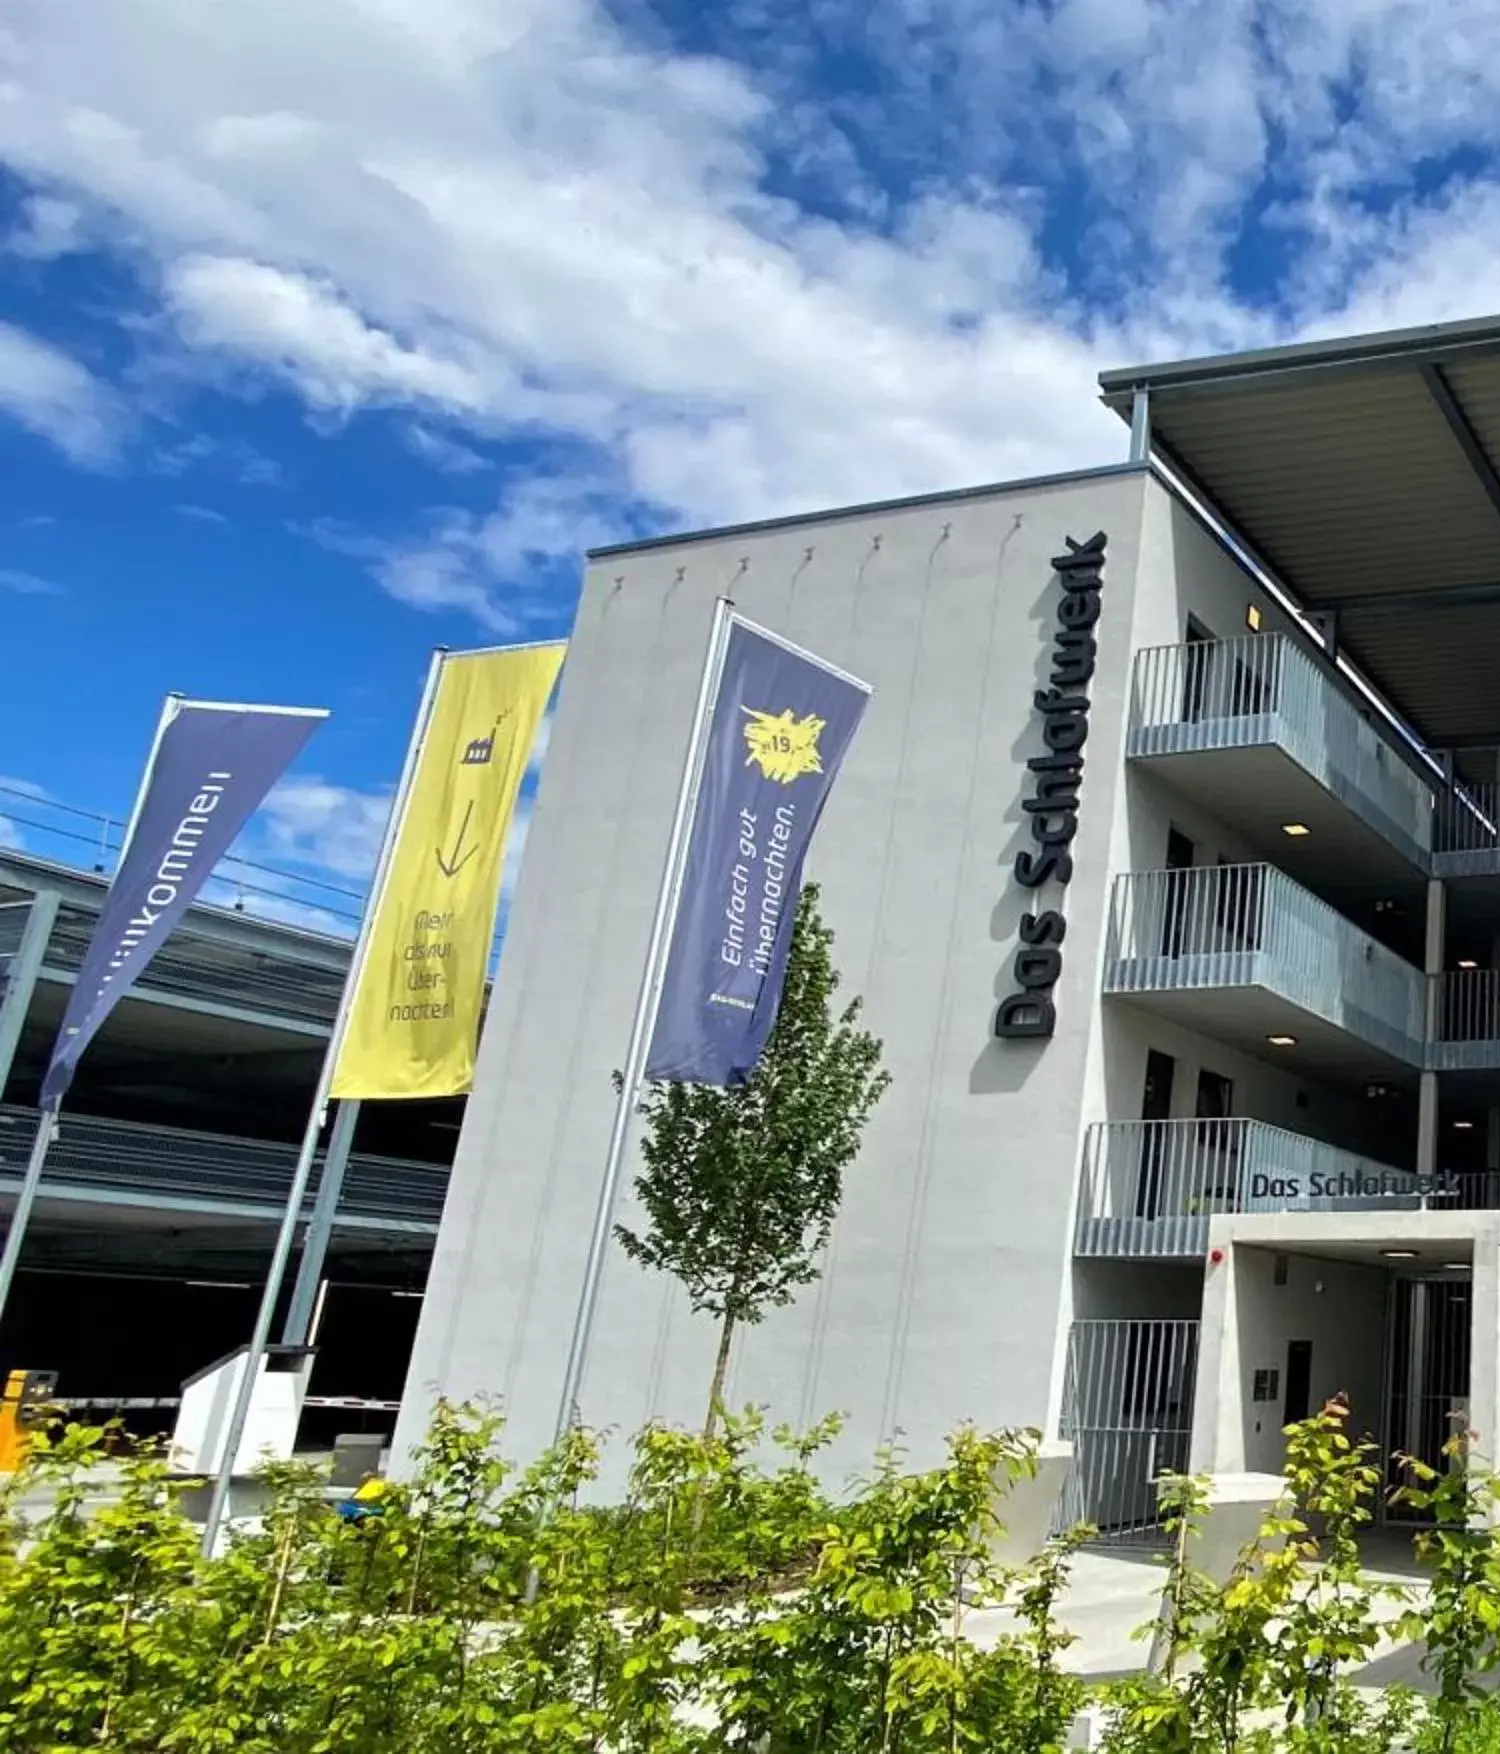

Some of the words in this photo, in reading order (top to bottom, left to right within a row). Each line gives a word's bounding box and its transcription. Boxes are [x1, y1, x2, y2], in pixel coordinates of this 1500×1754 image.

[1014, 530, 1108, 886] Schlafwerk
[722, 864, 749, 967] Einfach
[739, 806, 757, 859] gut
[996, 909, 1066, 1038] Das
[1252, 1173, 1300, 1198] Das
